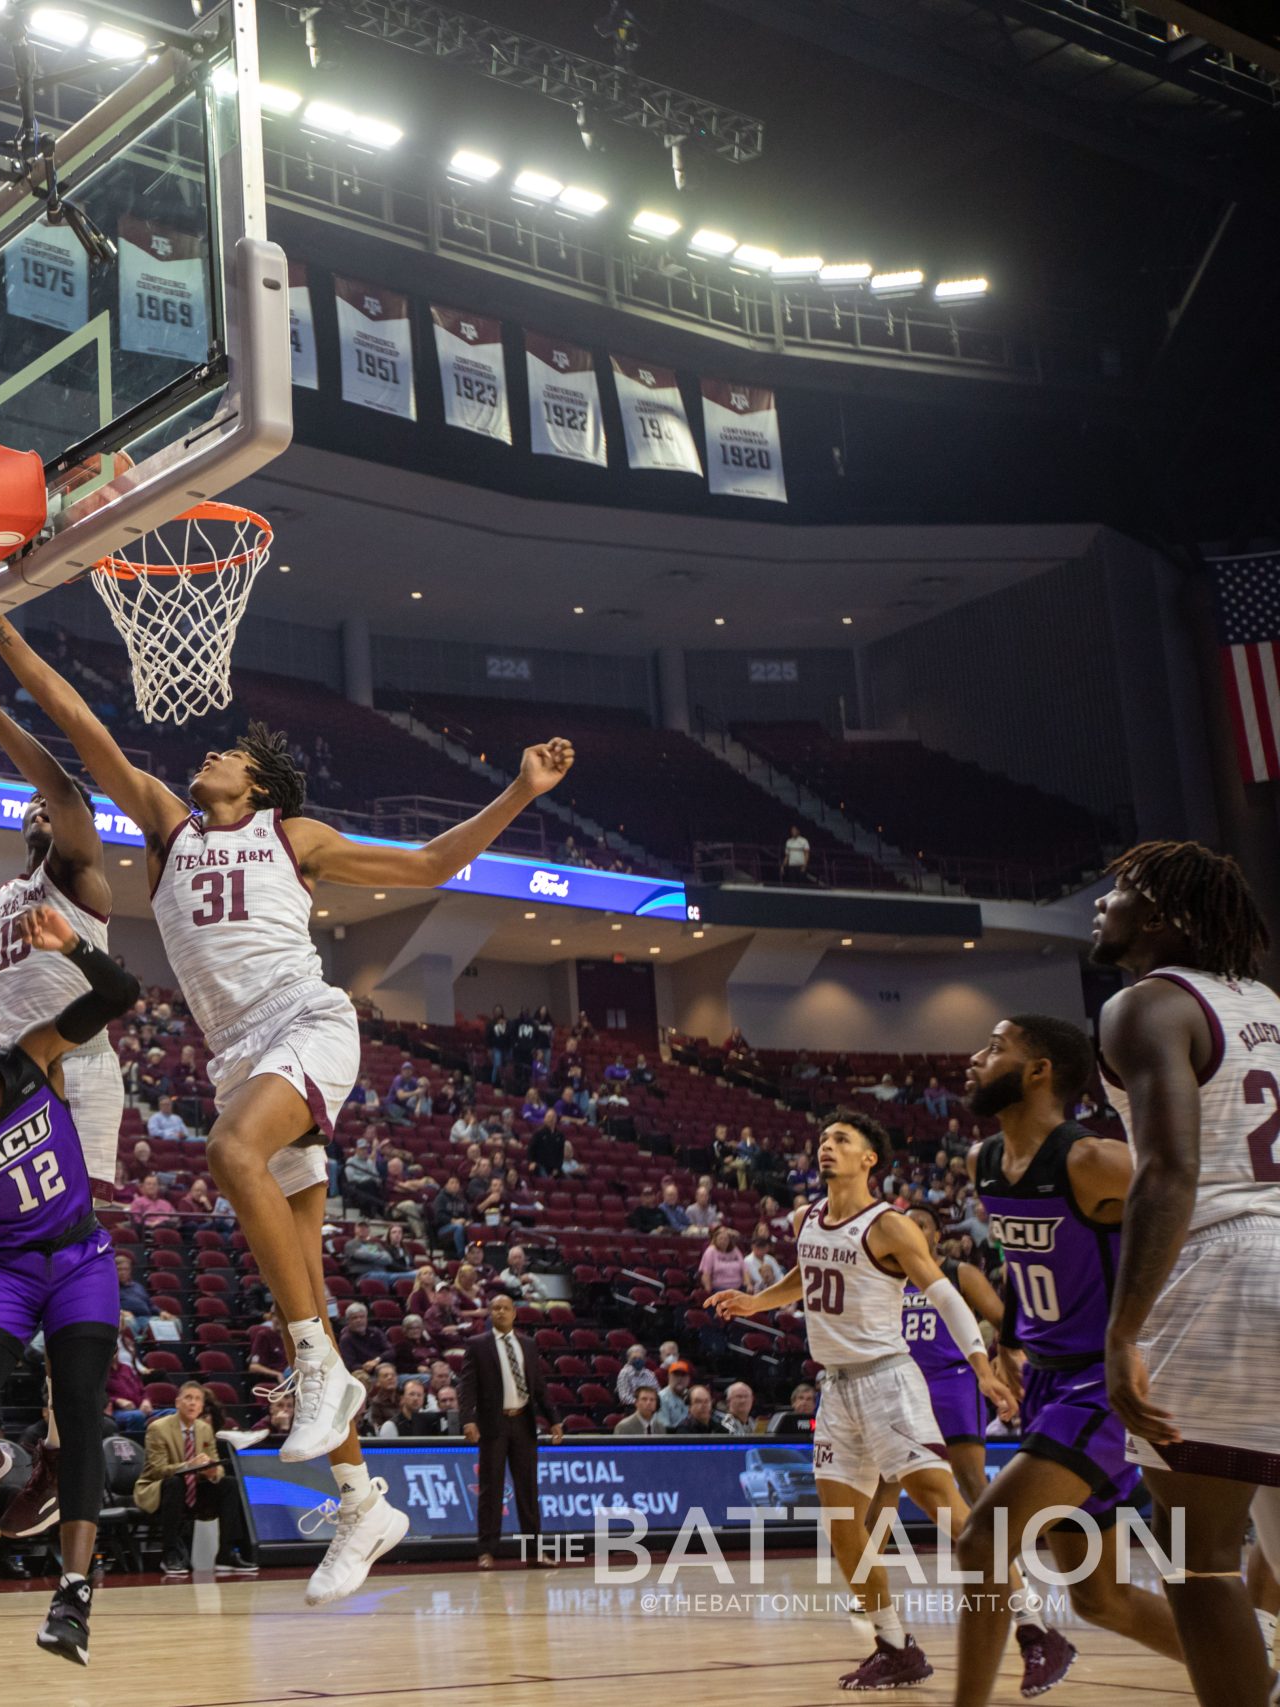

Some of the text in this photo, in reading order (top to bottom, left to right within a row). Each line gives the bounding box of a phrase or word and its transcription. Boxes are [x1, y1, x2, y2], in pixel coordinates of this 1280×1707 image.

[20, 255, 75, 298] 1975
[135, 291, 194, 328] 1969
[354, 348, 401, 386] 1951
[453, 372, 498, 409] 1923
[543, 400, 588, 432] 1922
[720, 443, 772, 471] 1920
[487, 656, 530, 679] 224
[750, 661, 797, 682] 225
[1, 800, 30, 819] TH
[175, 848, 274, 872] TEXAS A&M
[191, 868, 249, 927] 31
[529, 870, 569, 897] Ford
[1242, 1069, 1280, 1182] 2
[7, 1150, 67, 1213] 12
[989, 1217, 1060, 1250] ACU
[798, 1243, 858, 1265] TEXAS A&M
[804, 1265, 845, 1316] 20
[1009, 1261, 1061, 1322] 10
[905, 1312, 937, 1342] 23
[537, 1460, 625, 1485] FFICIAL
[609, 1493, 630, 1516] &
[631, 1491, 679, 1516] SUV
